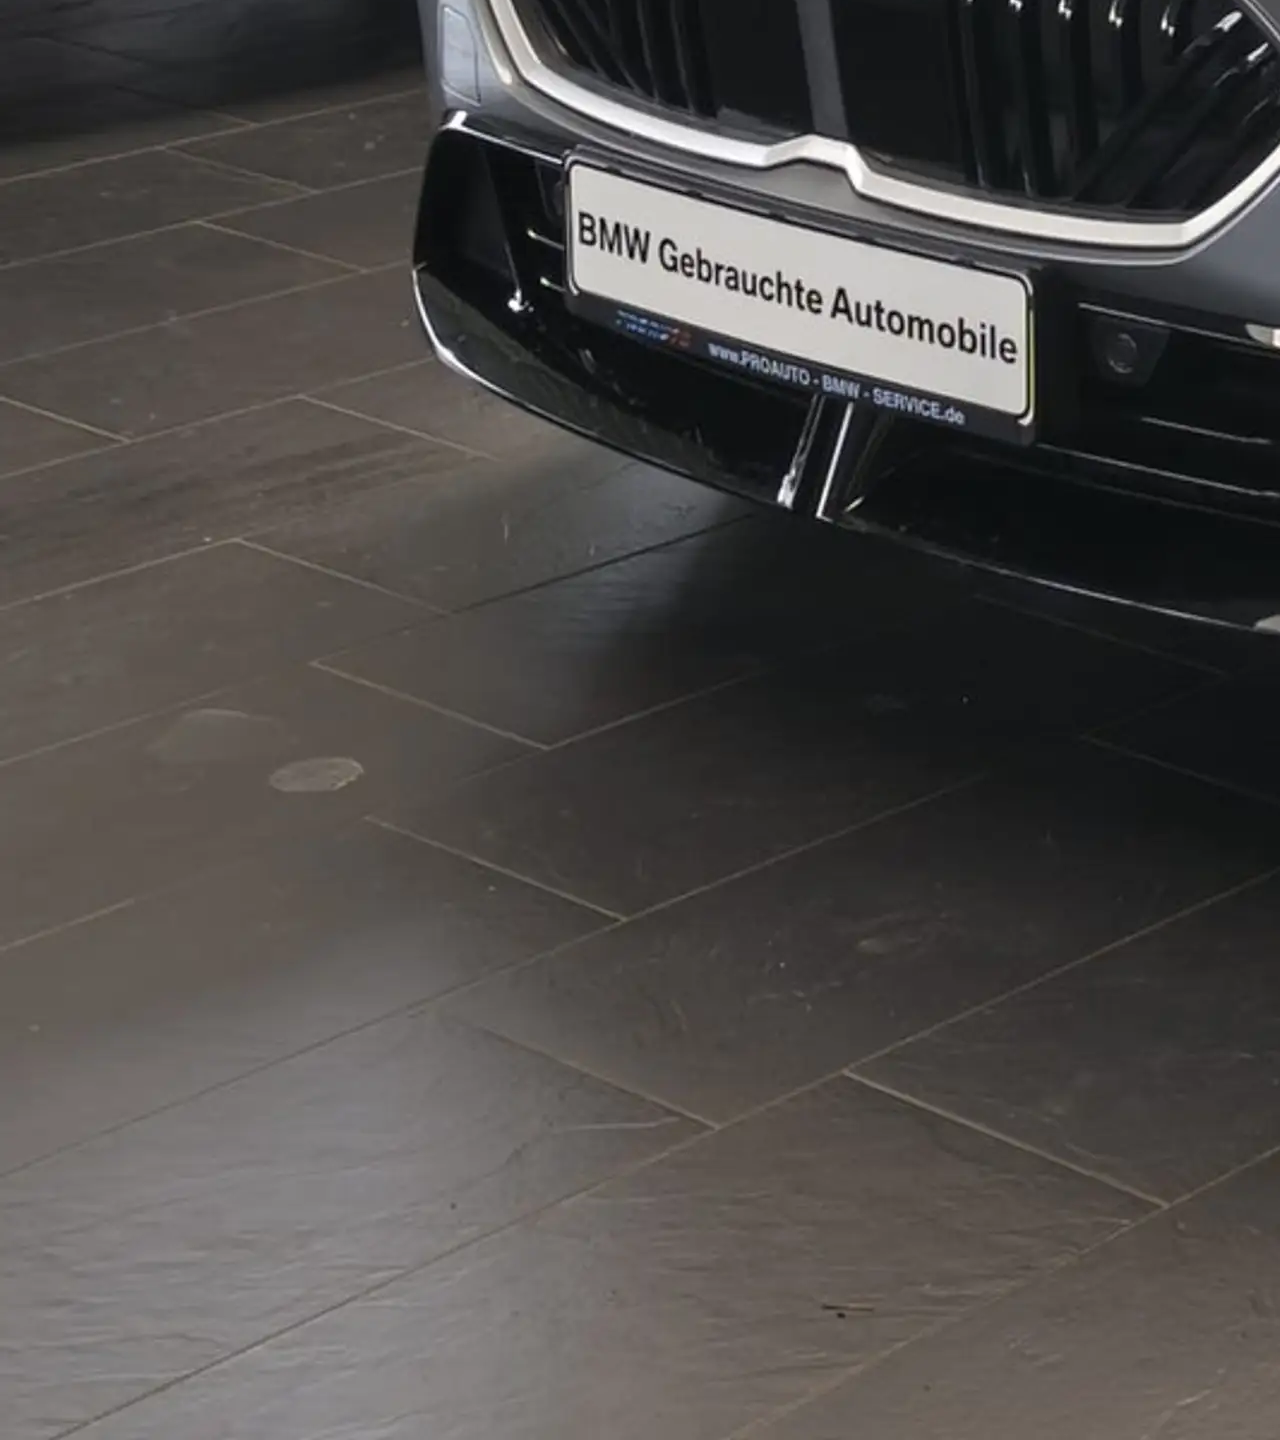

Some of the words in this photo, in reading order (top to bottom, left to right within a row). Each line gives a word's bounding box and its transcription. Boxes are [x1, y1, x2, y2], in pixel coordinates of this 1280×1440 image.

[578, 211, 651, 264] BMW
[658, 237, 823, 315] Gebrauchte
[830, 286, 1018, 364] Automobile
[708, 342, 810, 386] www.PROAUTO
[822, 374, 860, 400] BMW
[873, 387, 965, 425] SERVICE.de
